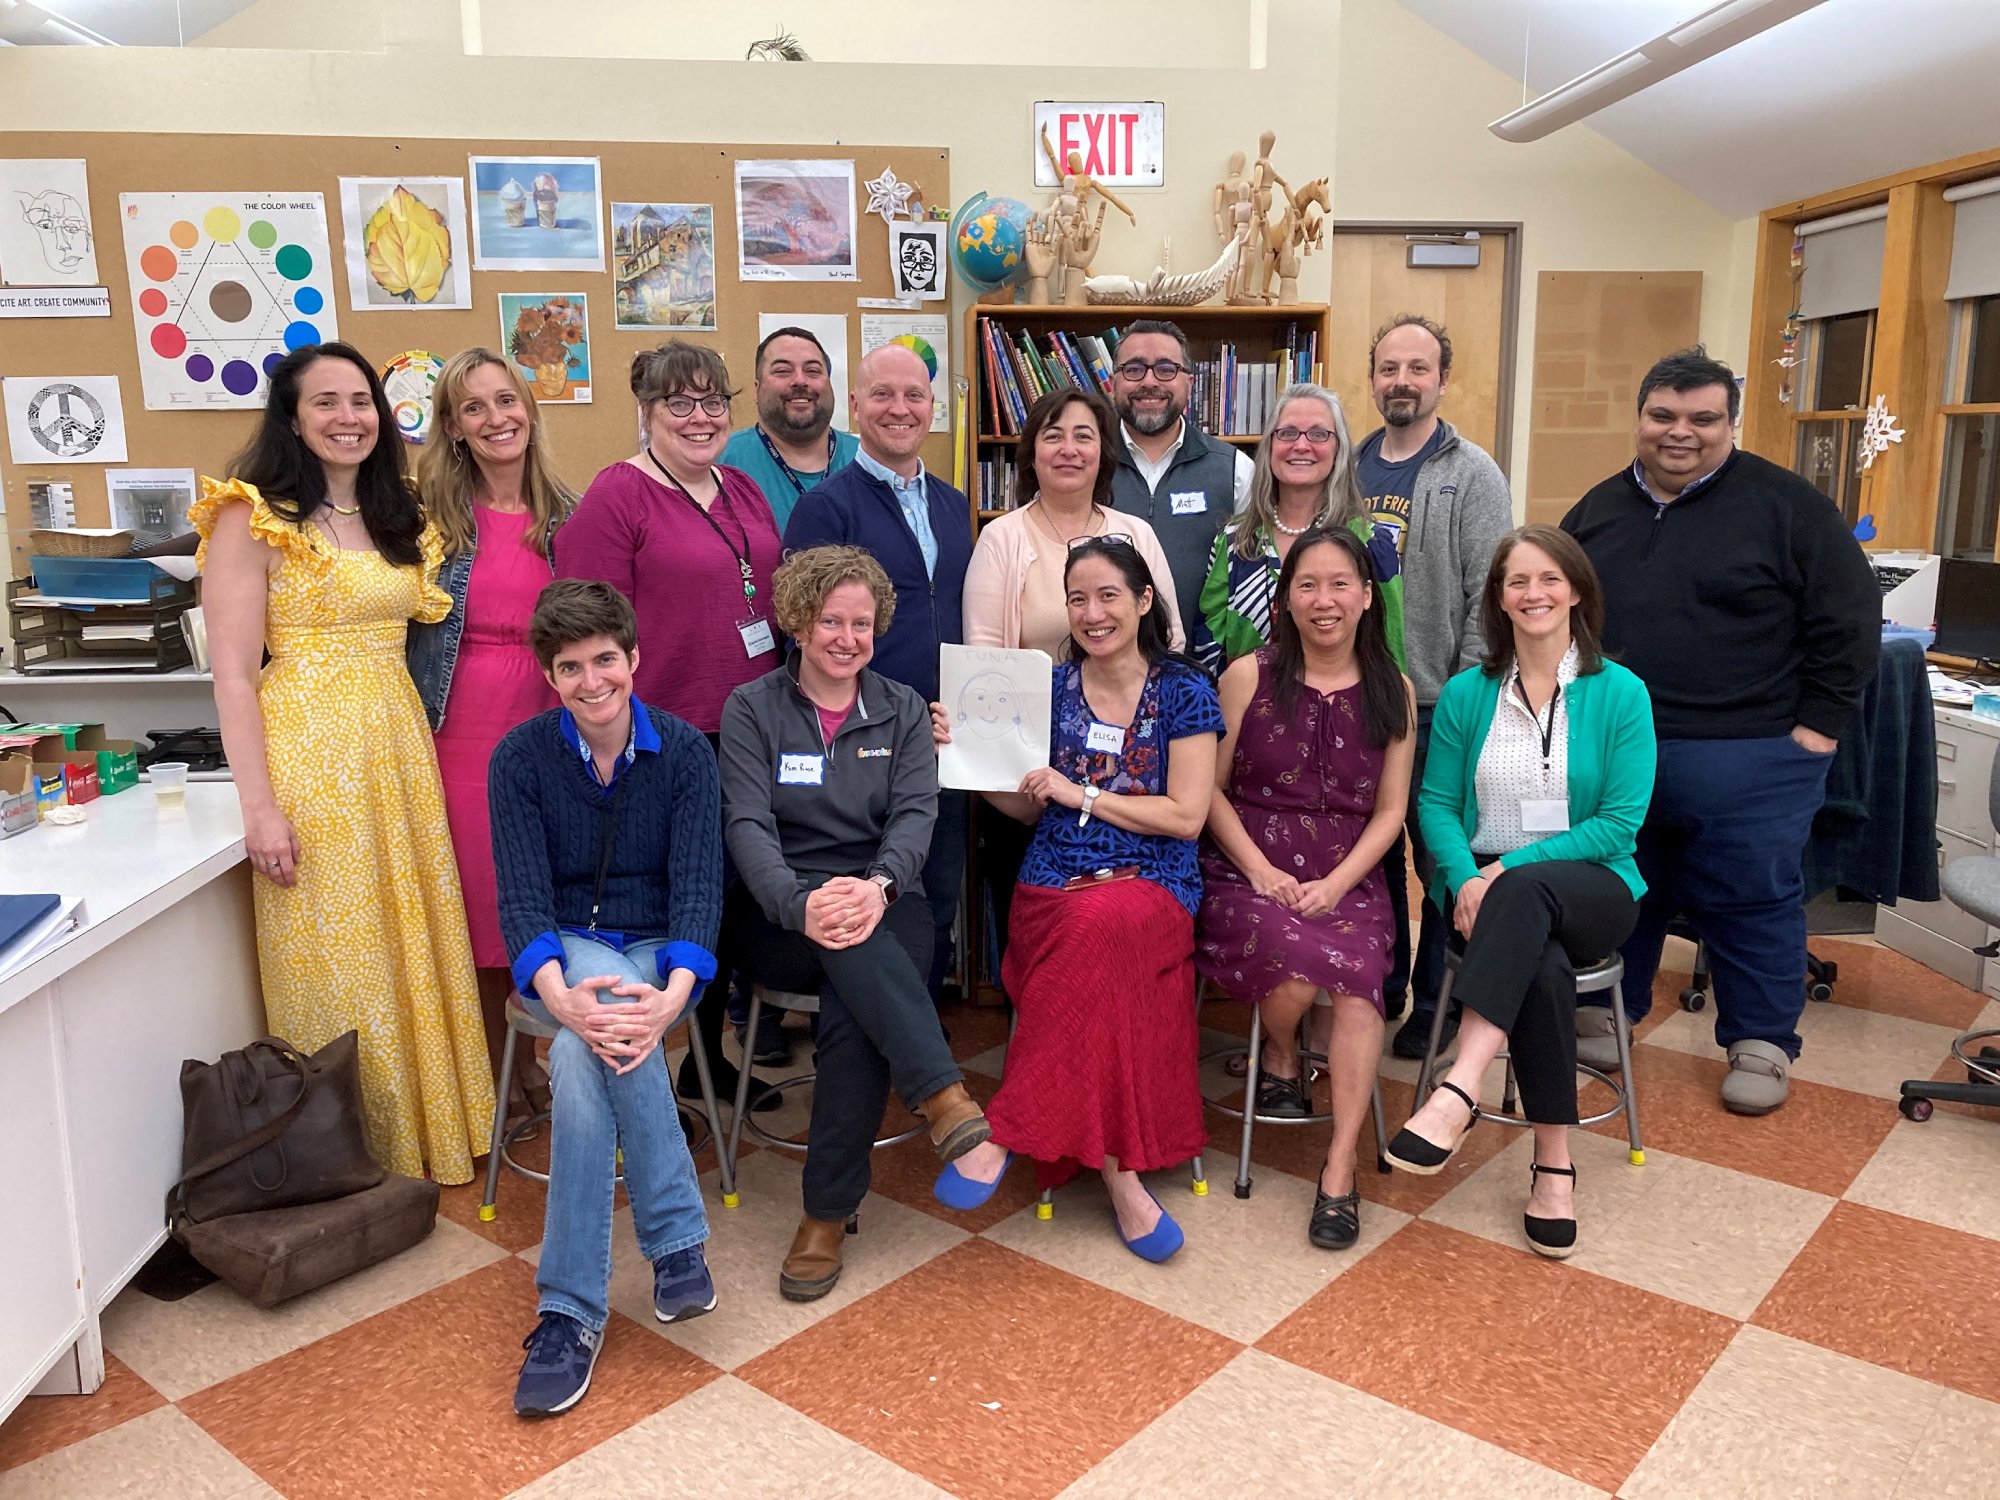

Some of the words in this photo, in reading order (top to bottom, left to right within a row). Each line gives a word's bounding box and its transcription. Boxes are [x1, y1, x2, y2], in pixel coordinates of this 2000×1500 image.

[1060, 114, 1139, 175] EXIT
[17, 298, 32, 307] ART.
[34, 298, 61, 307] CREATE
[1363, 496, 1380, 512] OT
[1383, 494, 1411, 517] FRIE
[961, 650, 1017, 662] TUNA
[1093, 731, 1117, 743] ELISA
